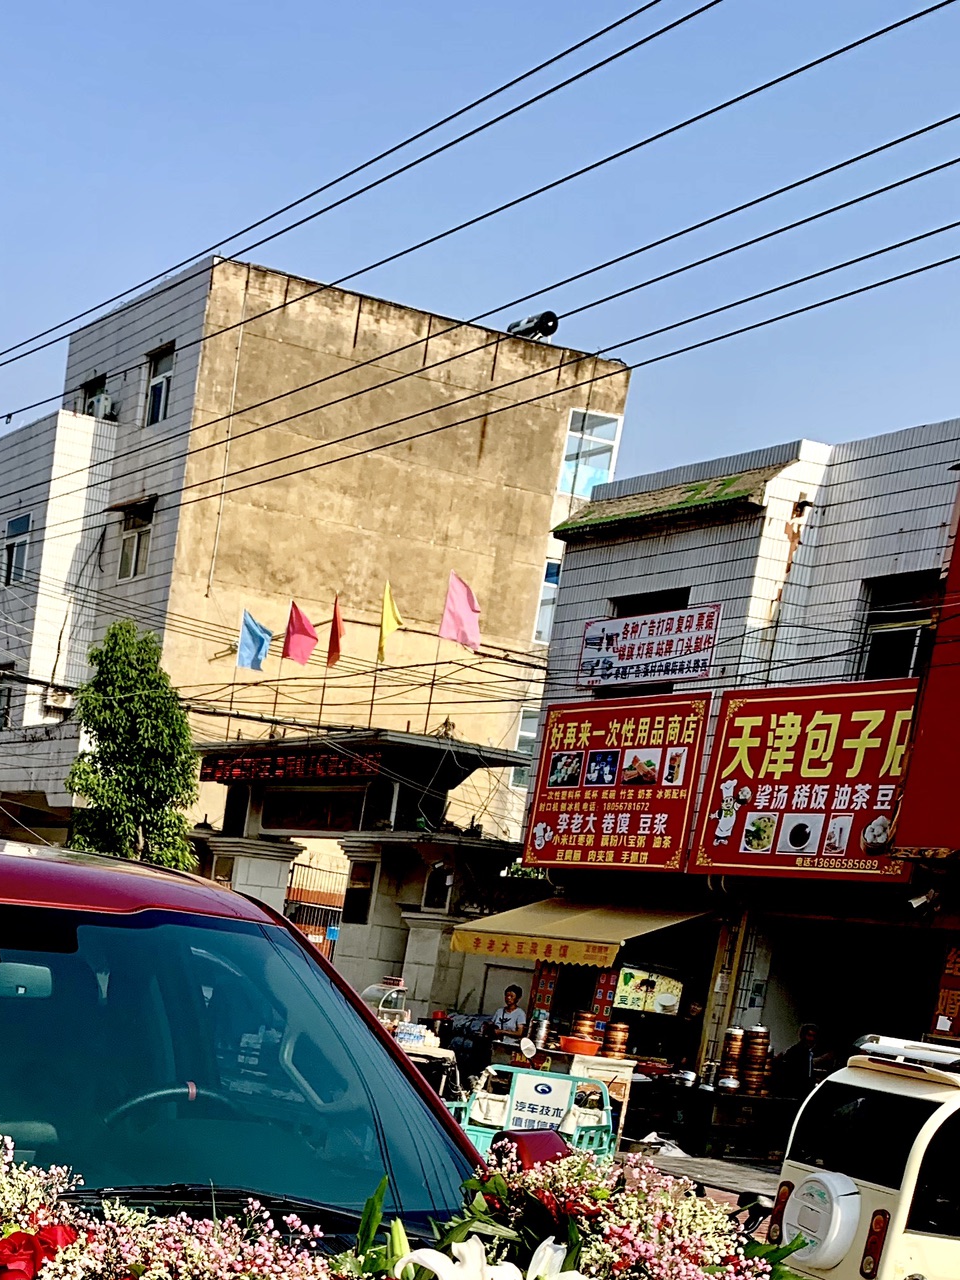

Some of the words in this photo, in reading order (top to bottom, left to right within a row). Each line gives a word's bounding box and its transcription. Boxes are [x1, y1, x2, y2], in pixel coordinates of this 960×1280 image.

[622, 617, 674, 640] 各种广告打印
[675, 614, 695, 634] 复印
[549, 713, 698, 750] 好再来一次性用品商店
[603, 802, 650, 811] 18056781672
[791, 784, 830, 810] 稀饭
[831, 783, 872, 810] 油茶
[556, 813, 597, 834] 李老大
[601, 813, 631, 834] 卷馍
[639, 813, 669, 835] 豆浆
[617, 995, 642, 1007] 豆浆
[514, 1100, 564, 1118] 汽车技术
